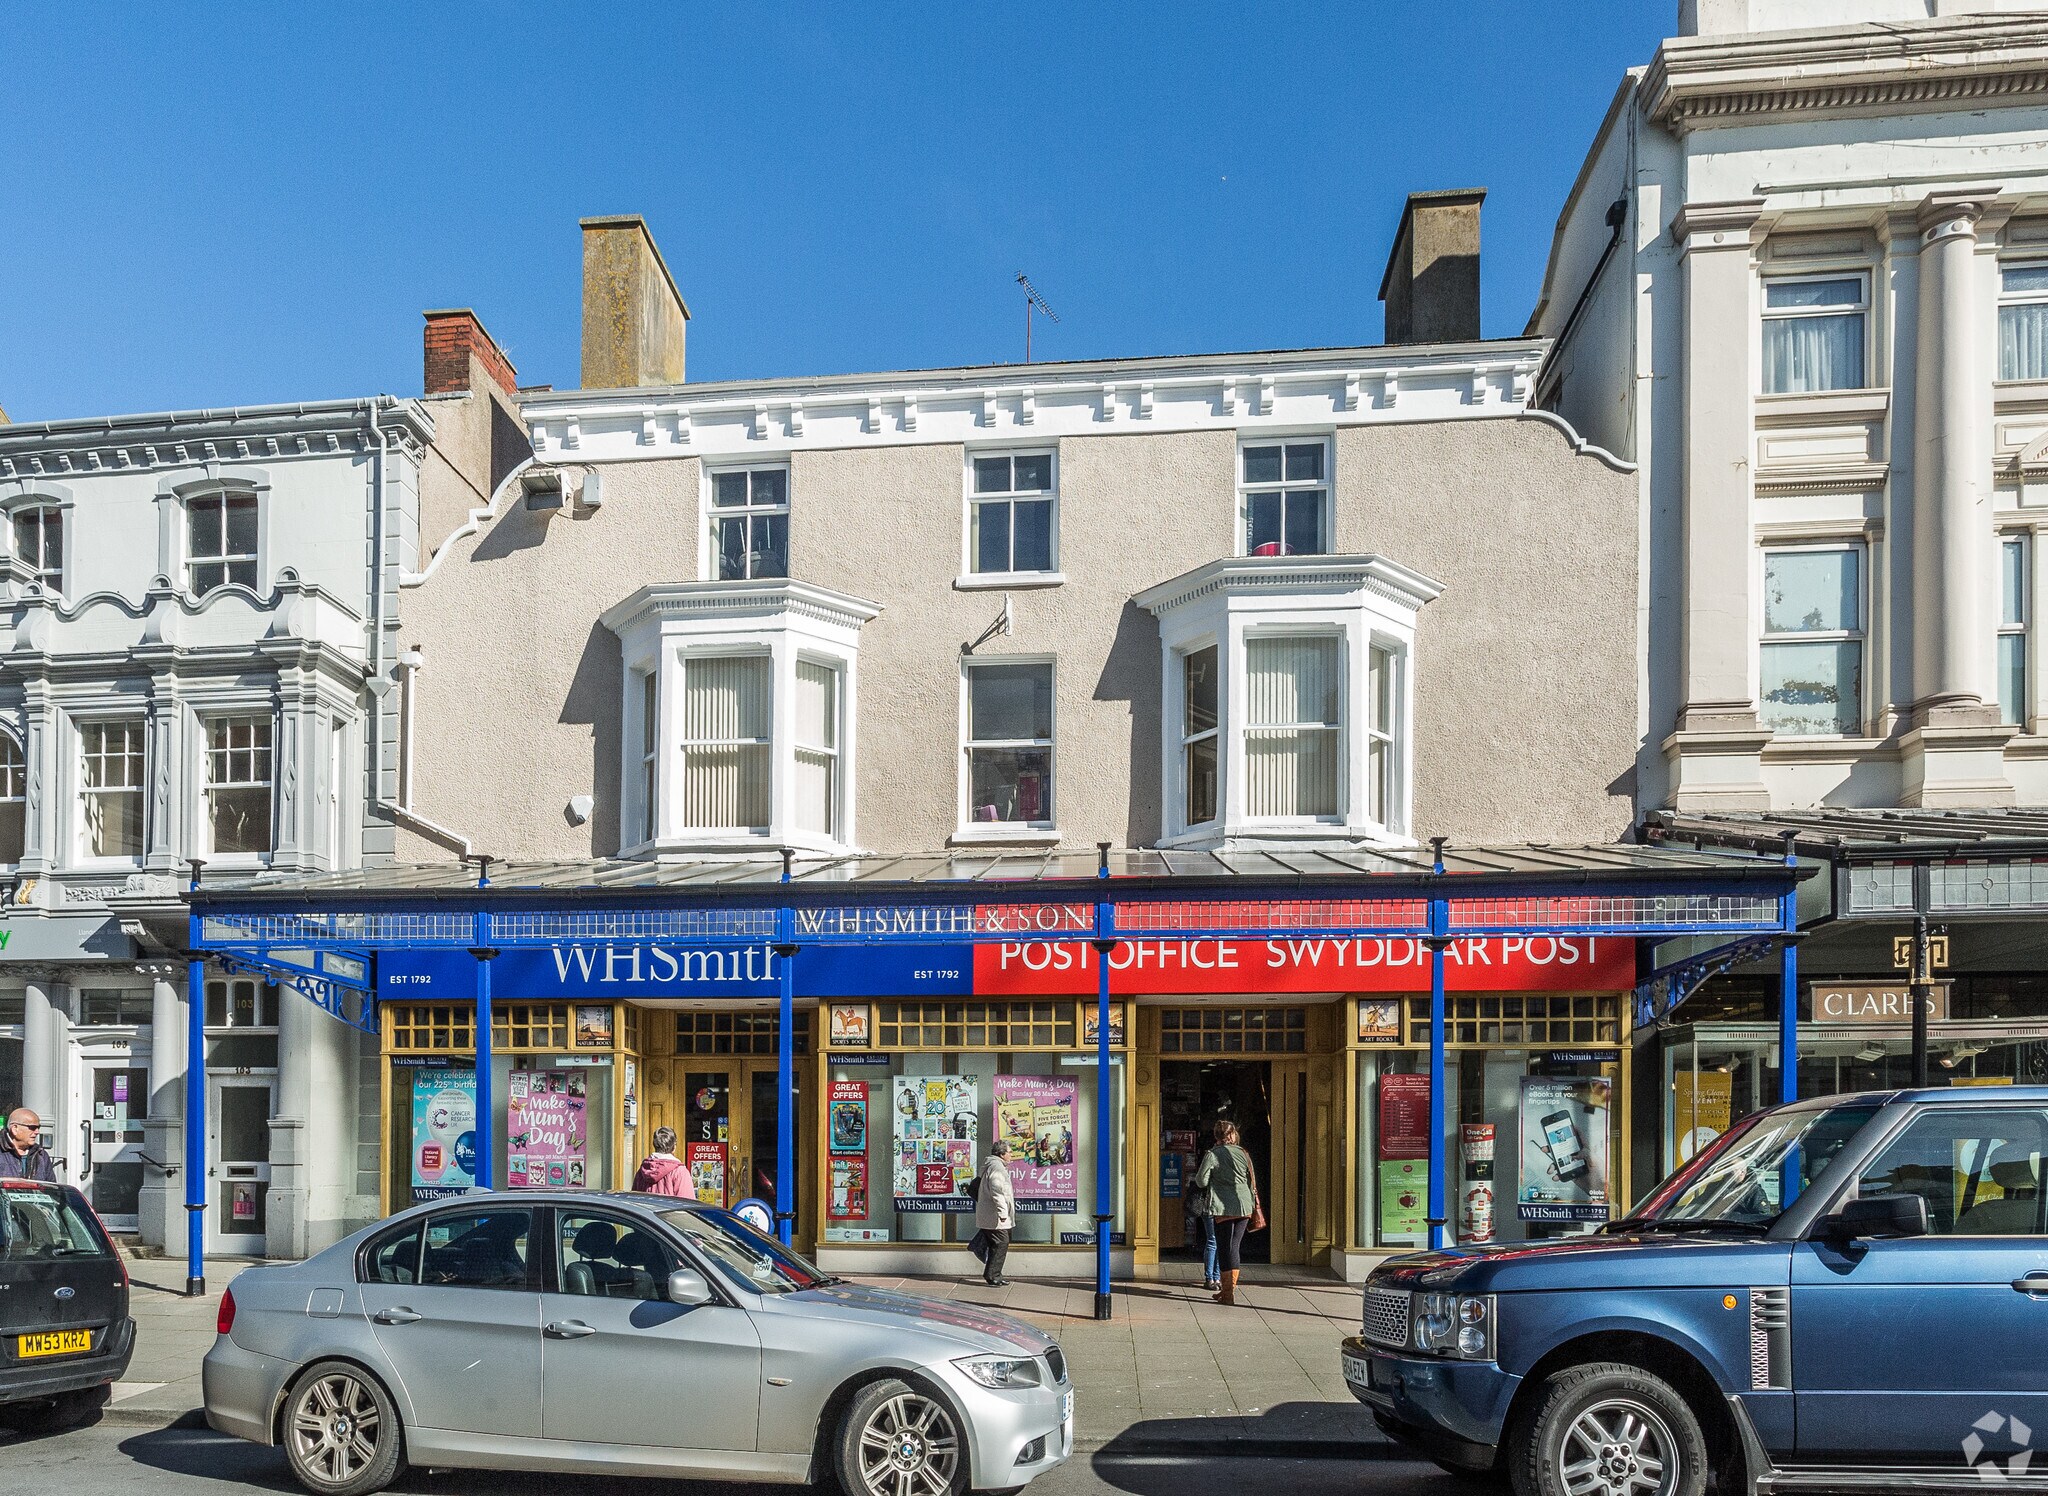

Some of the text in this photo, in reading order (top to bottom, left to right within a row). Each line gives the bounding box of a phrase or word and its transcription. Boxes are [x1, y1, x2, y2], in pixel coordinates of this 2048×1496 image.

[1018, 905, 1087, 931] SON
[1001, 937, 1096, 970] POST
[1108, 935, 1239, 970] OFFICE
[1502, 932, 1604, 965] POST
[551, 936, 782, 983] WHSmith
[390, 975, 431, 984] EST 1792
[914, 970, 959, 979] EST 1792
[236, 1000, 253, 1009] 103
[112, 1041, 128, 1049] 103
[393, 1057, 426, 1065] WHSmith
[829, 1055, 865, 1063] WHSmith
[1552, 1053, 1592, 1061] WHSmith
[235, 1067, 251, 1075] 103
[420, 1071, 476, 1079] We're celebrati
[453, 1080, 477, 1089] birthd
[835, 1083, 861, 1091] GREAT
[997, 1077, 1075, 1093] Make Mum's Day
[530, 1094, 566, 1111] Make
[926, 1100, 946, 1115] 20
[518, 1107, 578, 1133] Mum's
[528, 1127, 566, 1155] Day
[847, 1161, 864, 1169] Price
[923, 1166, 931, 1181] 3
[941, 1166, 950, 1180] 2
[1009, 1168, 1026, 1181] nly
[897, 1199, 943, 1211] WHSmith
[1015, 1200, 1043, 1211] Smith
[1521, 1207, 1572, 1219] WHSmith
[26, 1331, 86, 1353] MW53 KRZ
